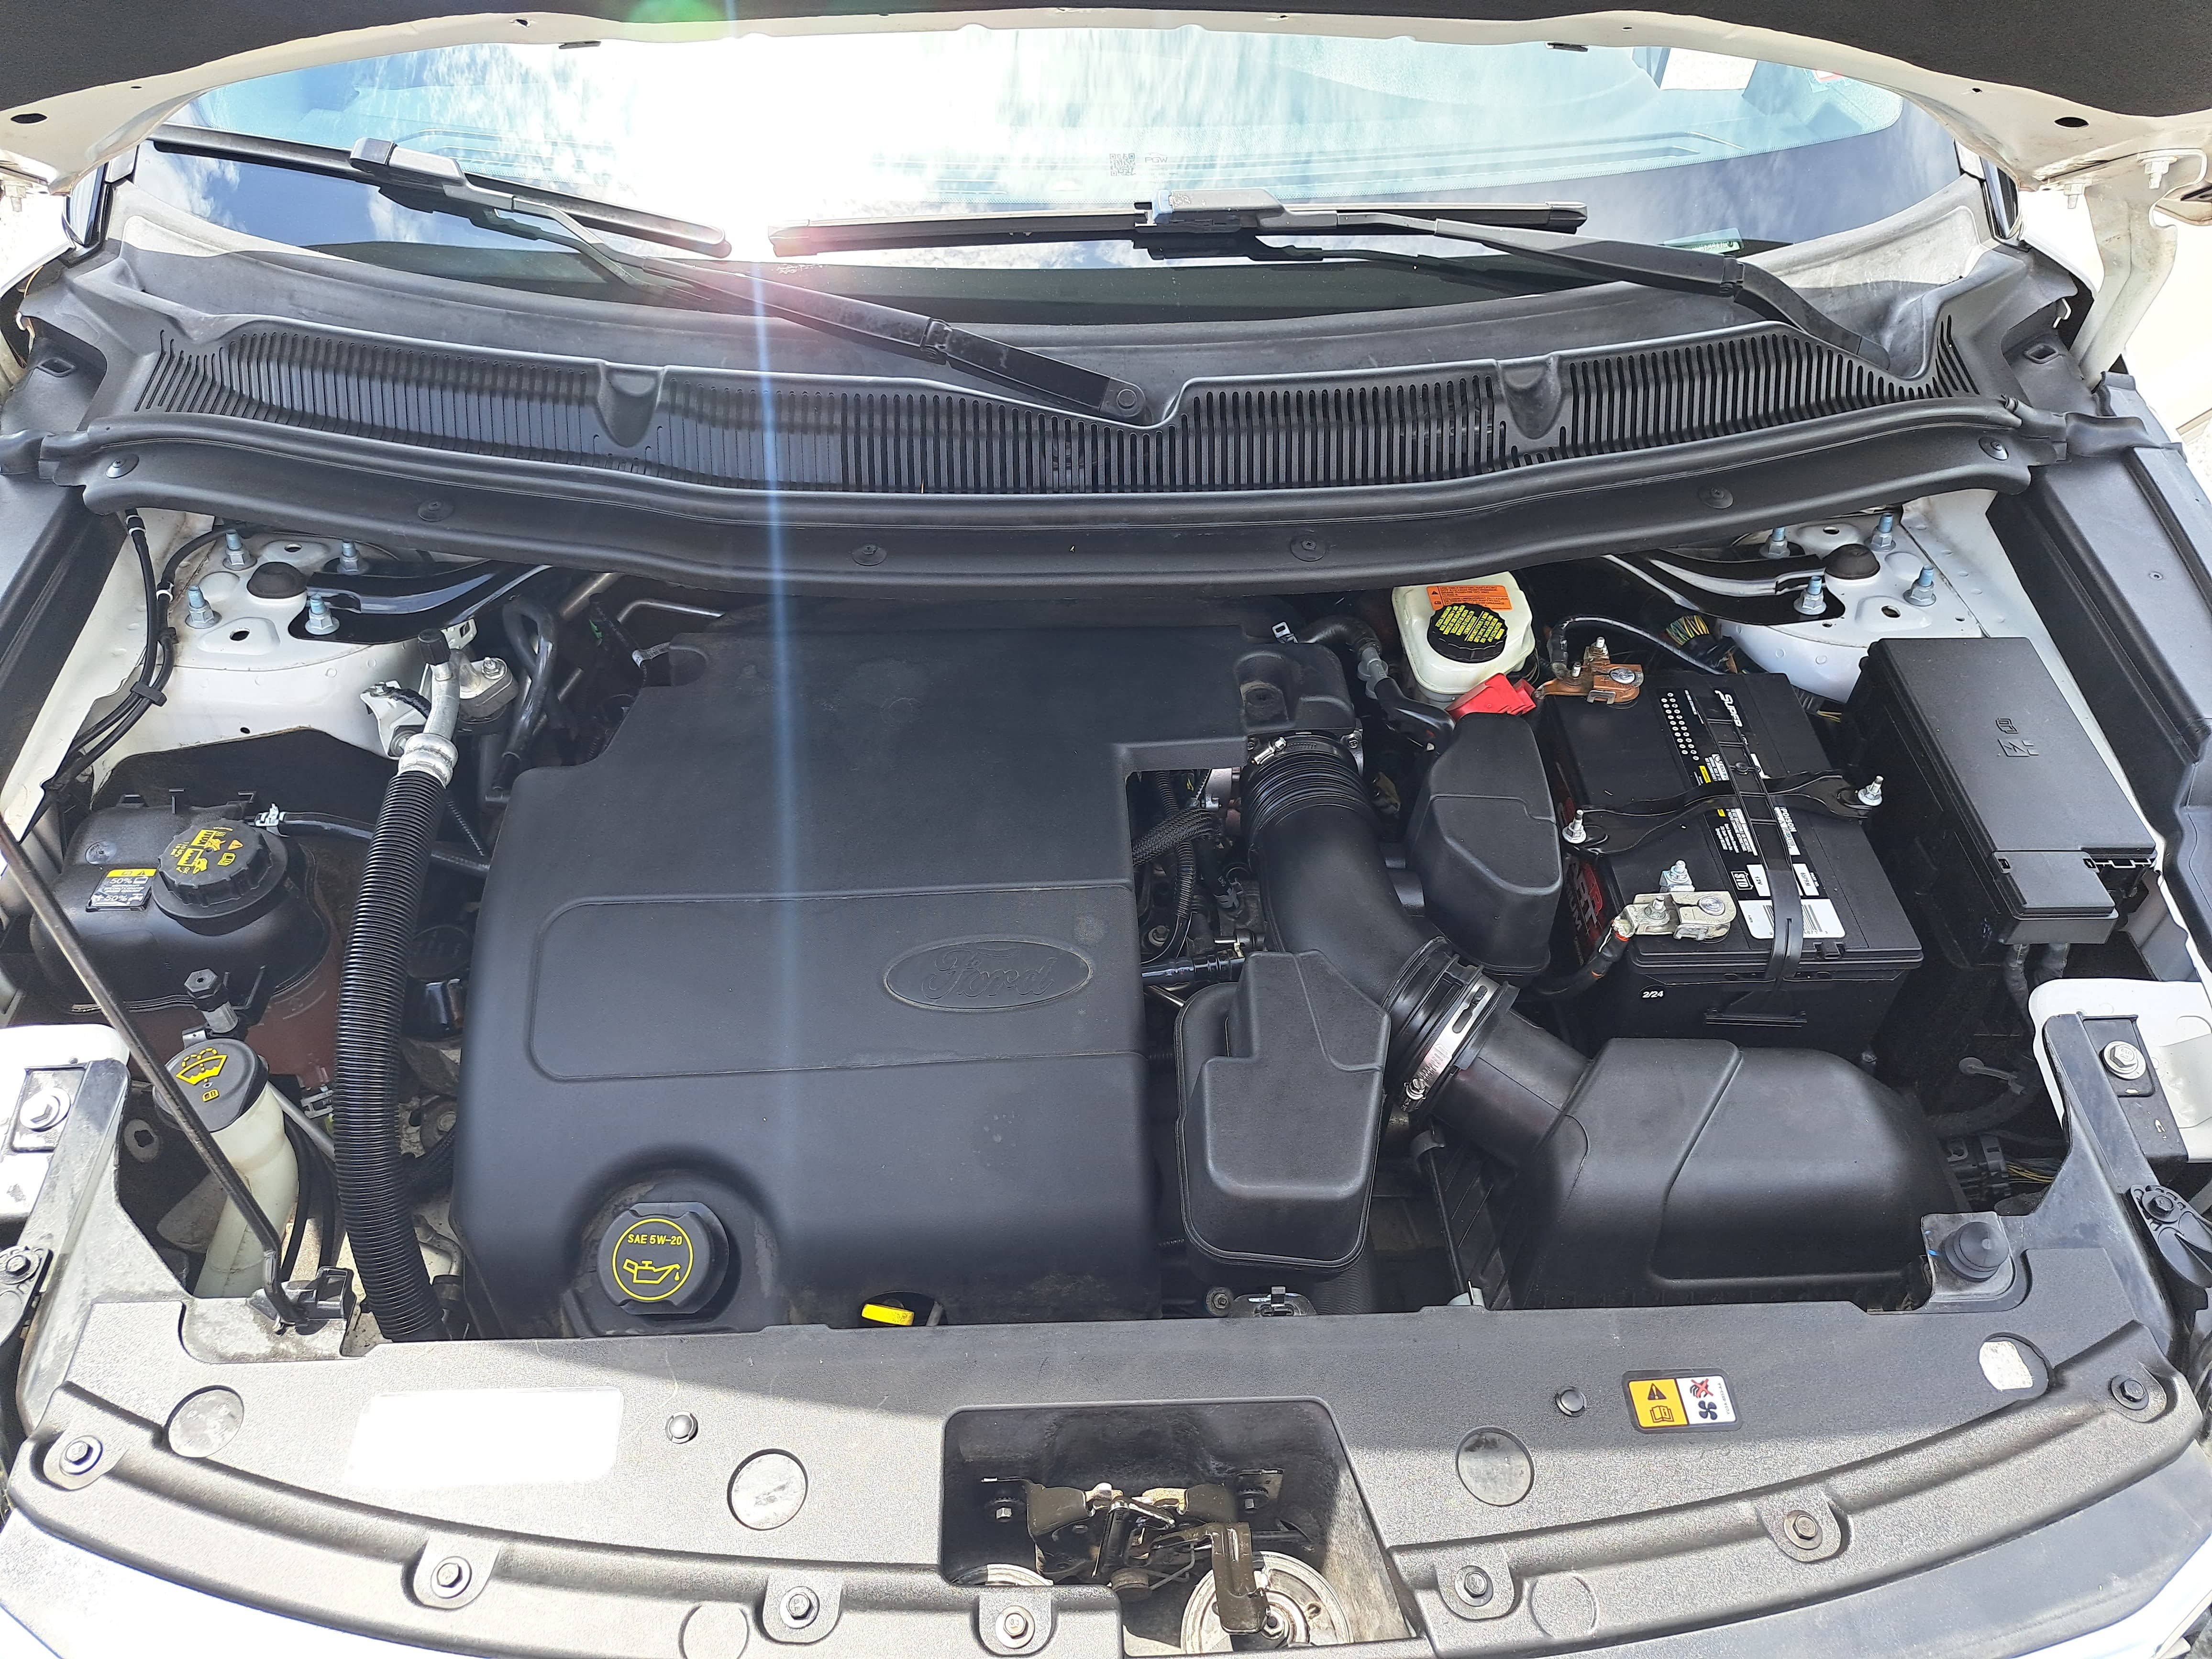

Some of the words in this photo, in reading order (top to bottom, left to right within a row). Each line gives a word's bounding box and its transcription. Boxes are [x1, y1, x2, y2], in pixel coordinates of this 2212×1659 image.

[1782, 807, 1798, 832] POISON
[1734, 873, 1748, 889] STD
[921, 947, 1056, 1000] Ford
[628, 1234, 647, 1244] SAE
[649, 1235, 683, 1245] 5W-20
